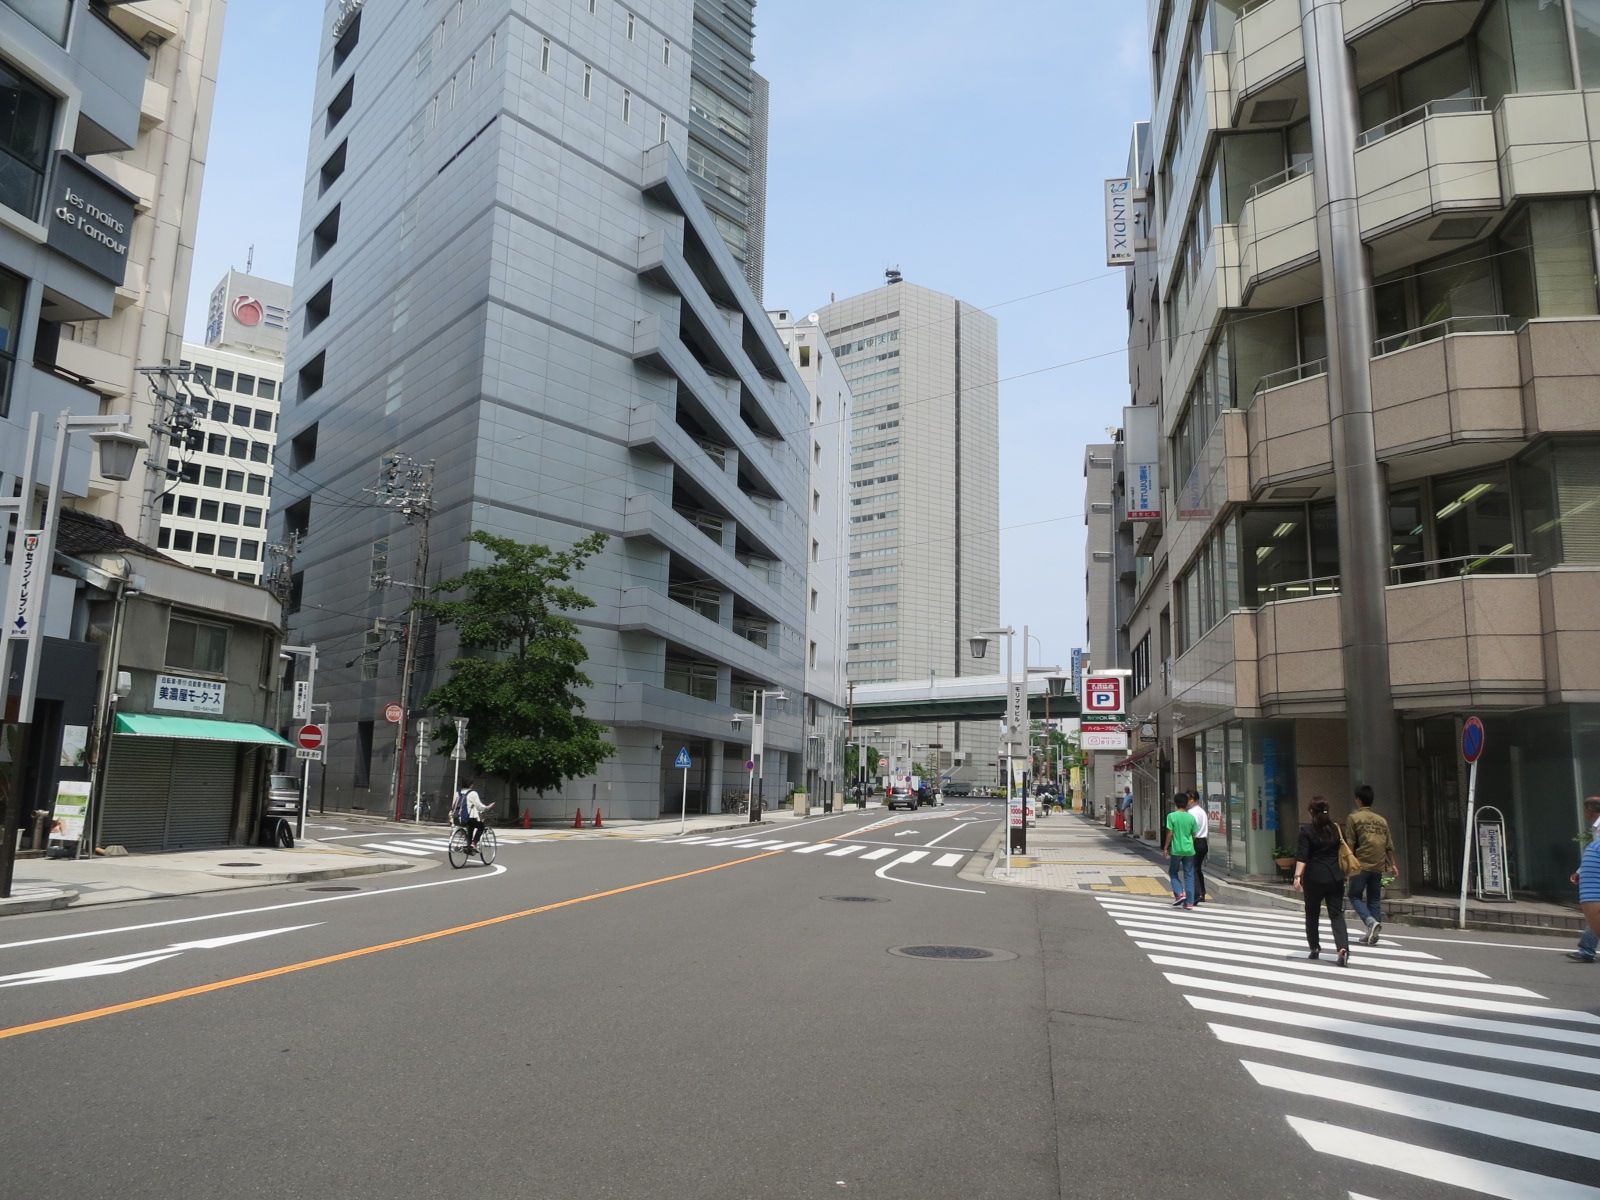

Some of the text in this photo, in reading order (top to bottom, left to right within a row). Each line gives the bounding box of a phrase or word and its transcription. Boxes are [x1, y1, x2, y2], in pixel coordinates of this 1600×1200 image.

[56, 207, 127, 255] de l'amour
[65, 187, 124, 234] les mains
[1096, 693, 1111, 705] P
